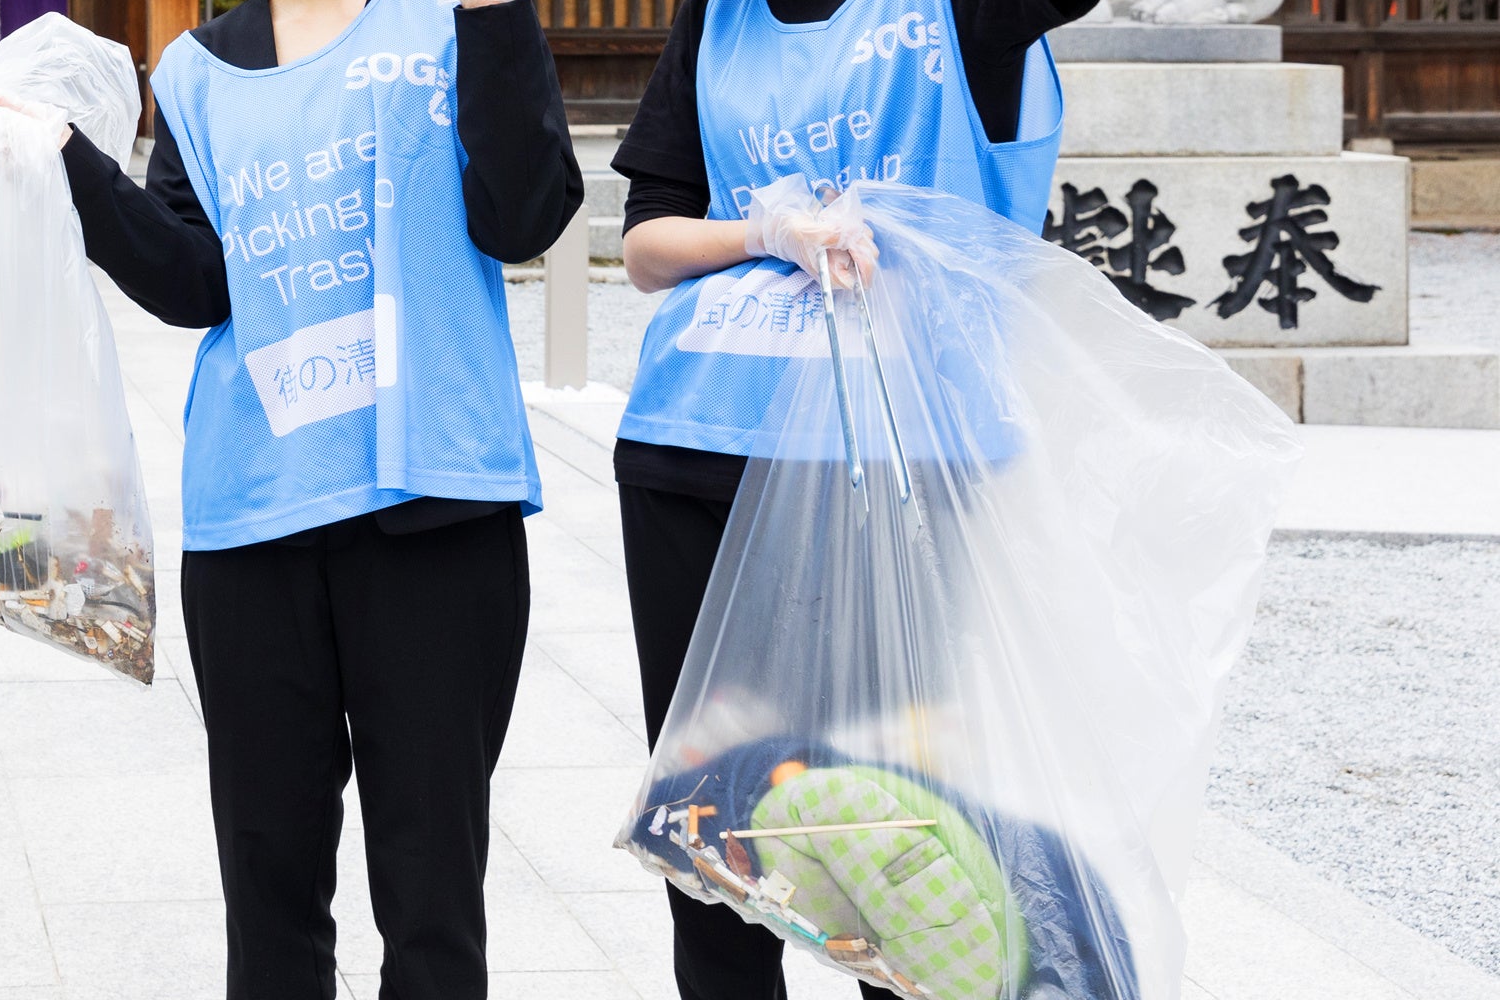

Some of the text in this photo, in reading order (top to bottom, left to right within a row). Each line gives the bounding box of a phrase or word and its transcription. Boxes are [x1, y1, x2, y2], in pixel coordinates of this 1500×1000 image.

[228, 130, 376, 207] We are
[739, 107, 872, 165] We are
